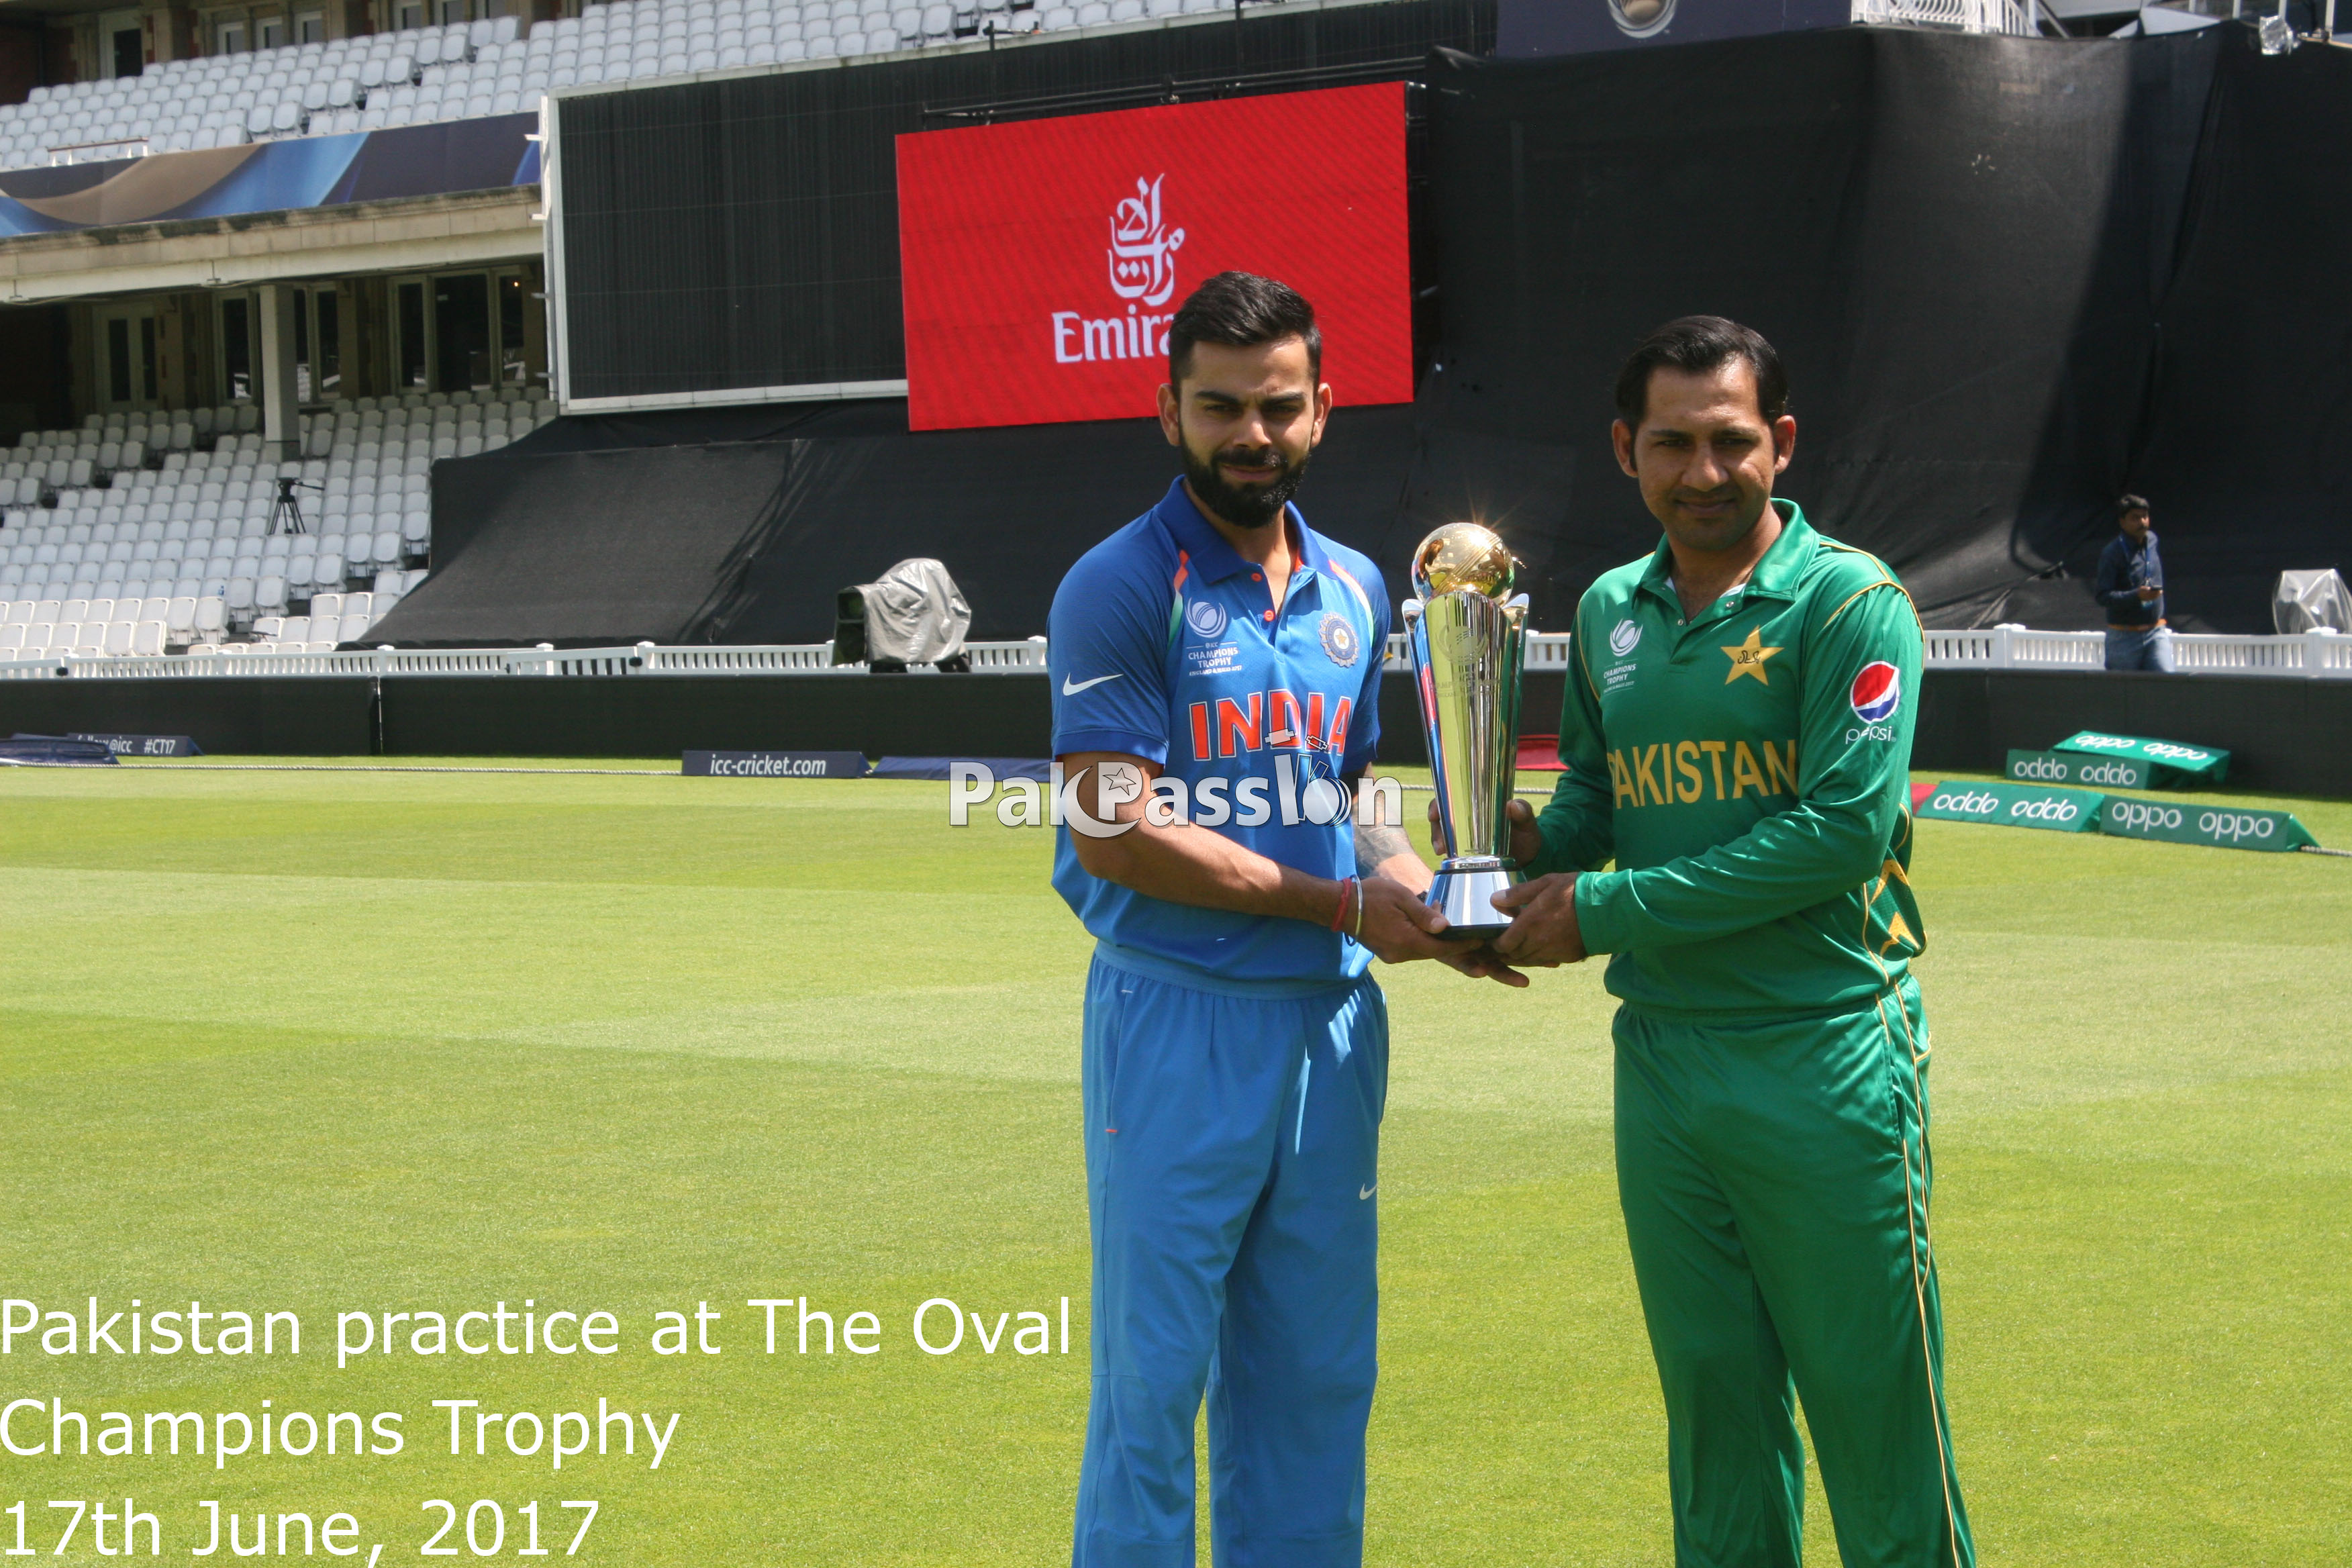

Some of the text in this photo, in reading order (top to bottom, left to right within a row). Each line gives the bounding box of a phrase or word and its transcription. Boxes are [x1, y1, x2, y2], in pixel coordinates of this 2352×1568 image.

[1051, 303, 1175, 363] Emira
[1187, 647, 1239, 660] CHAMPIONS
[1197, 656, 1232, 669] TROPHY
[1603, 663, 1637, 679] CHAMPIONS
[1606, 673, 1629, 686] TROPHY
[1189, 689, 1353, 761] INDIA
[1845, 726, 1893, 745] pepsi
[144, 739, 176, 754] #CT17
[710, 754, 826, 775] icc-cricket.com
[2112, 801, 2274, 842] oppo oppo
